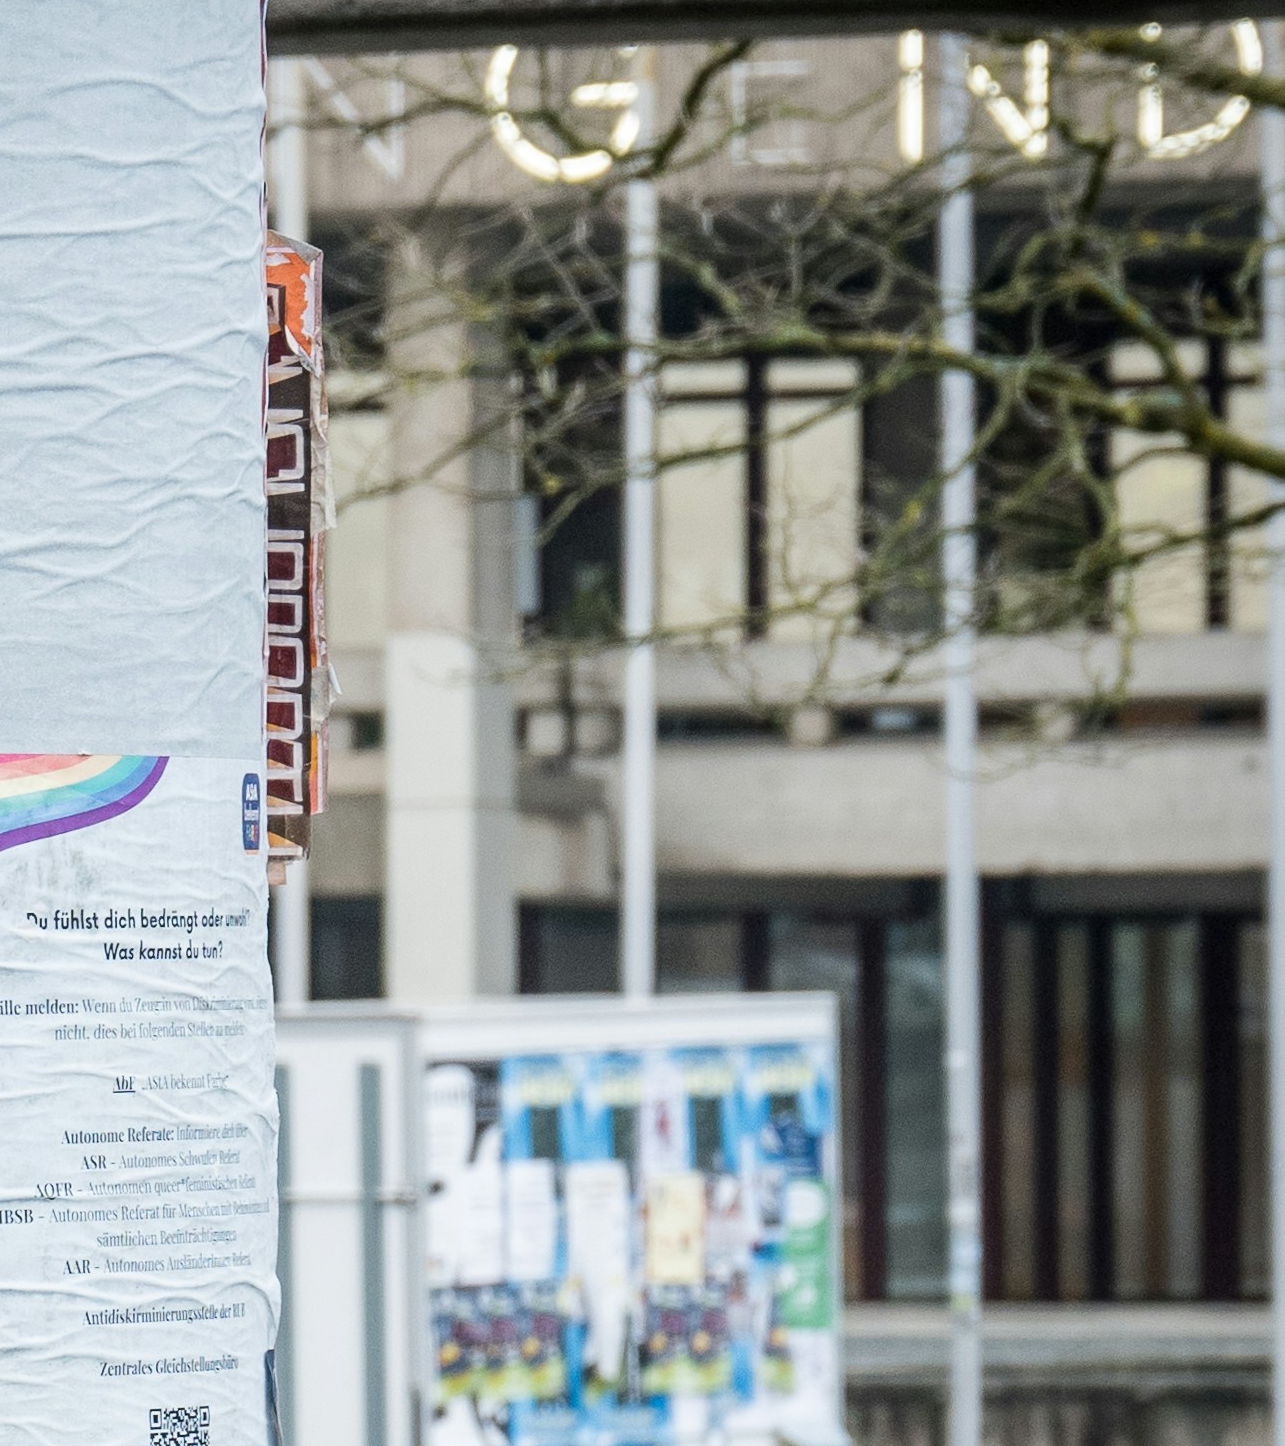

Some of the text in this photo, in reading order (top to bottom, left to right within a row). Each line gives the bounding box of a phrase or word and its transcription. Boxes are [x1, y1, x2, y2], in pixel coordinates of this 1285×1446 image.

[54, 909, 99, 930] fühlst
[104, 909, 135, 929] dich
[141, 908, 197, 933] bedrängt
[202, 908, 223, 927] oder
[104, 940, 222, 960] Was kannst du tun?
[26, 999, 78, 1015] melden:
[93, 1023, 117, 1039] dies
[120, 1023, 136, 1038] bei
[61, 1127, 174, 1145] Autonome Referate:
[81, 1155, 107, 1170] ASR
[49, 1206, 118, 1224] Autonomes
[121, 1204, 160, 1220] Referat
[63, 1260, 90, 1274] AAR
[100, 1360, 152, 1377] Zentrales
